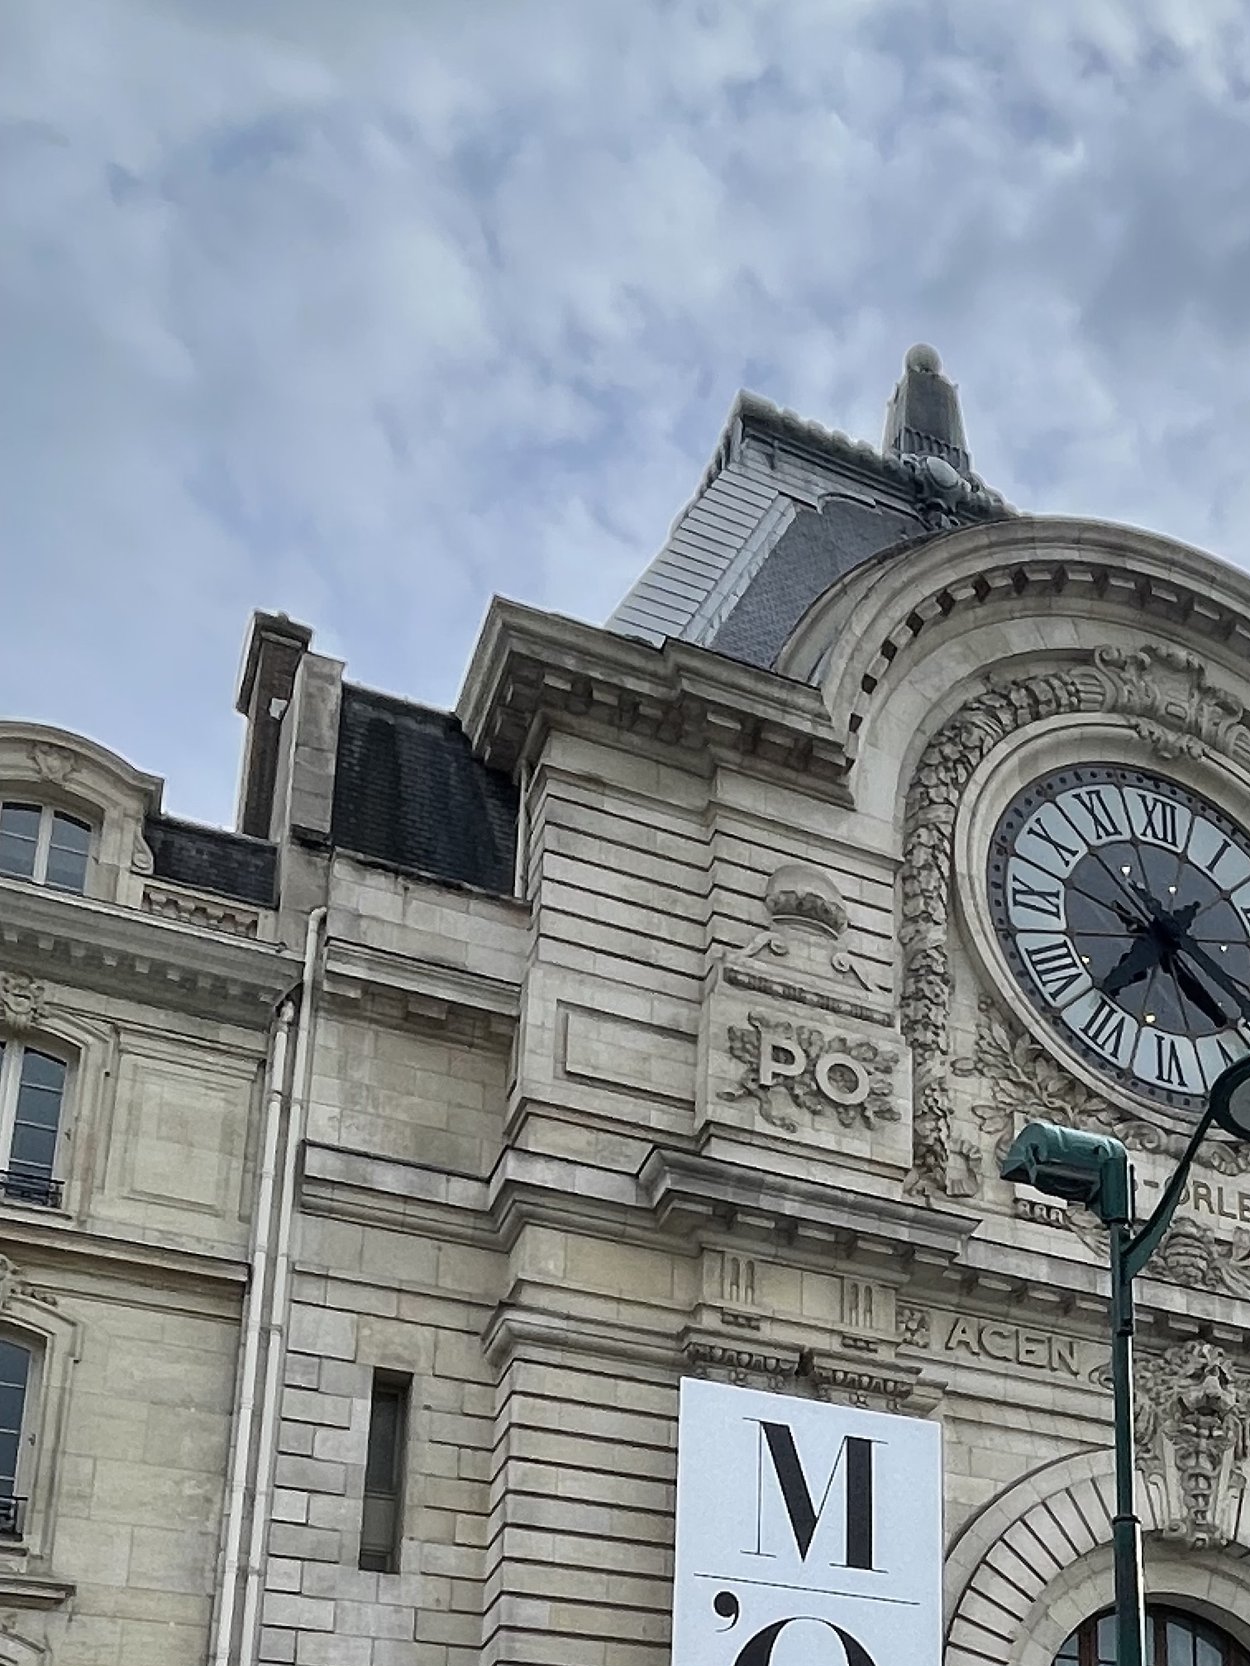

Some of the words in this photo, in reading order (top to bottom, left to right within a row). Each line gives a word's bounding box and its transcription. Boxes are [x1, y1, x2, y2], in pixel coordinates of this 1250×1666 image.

[1028, 817, 1079, 867] X
[1072, 790, 1121, 841] XI
[1138, 794, 1181, 848] XII
[1206, 839, 1232, 872] I
[1012, 873, 1061, 919] IX
[1026, 940, 1083, 1001] VIII
[1079, 998, 1124, 1062] VII
[758, 1036, 872, 1105] PO
[1153, 1033, 1188, 1088] VI
[740, 1417, 889, 1574] M
